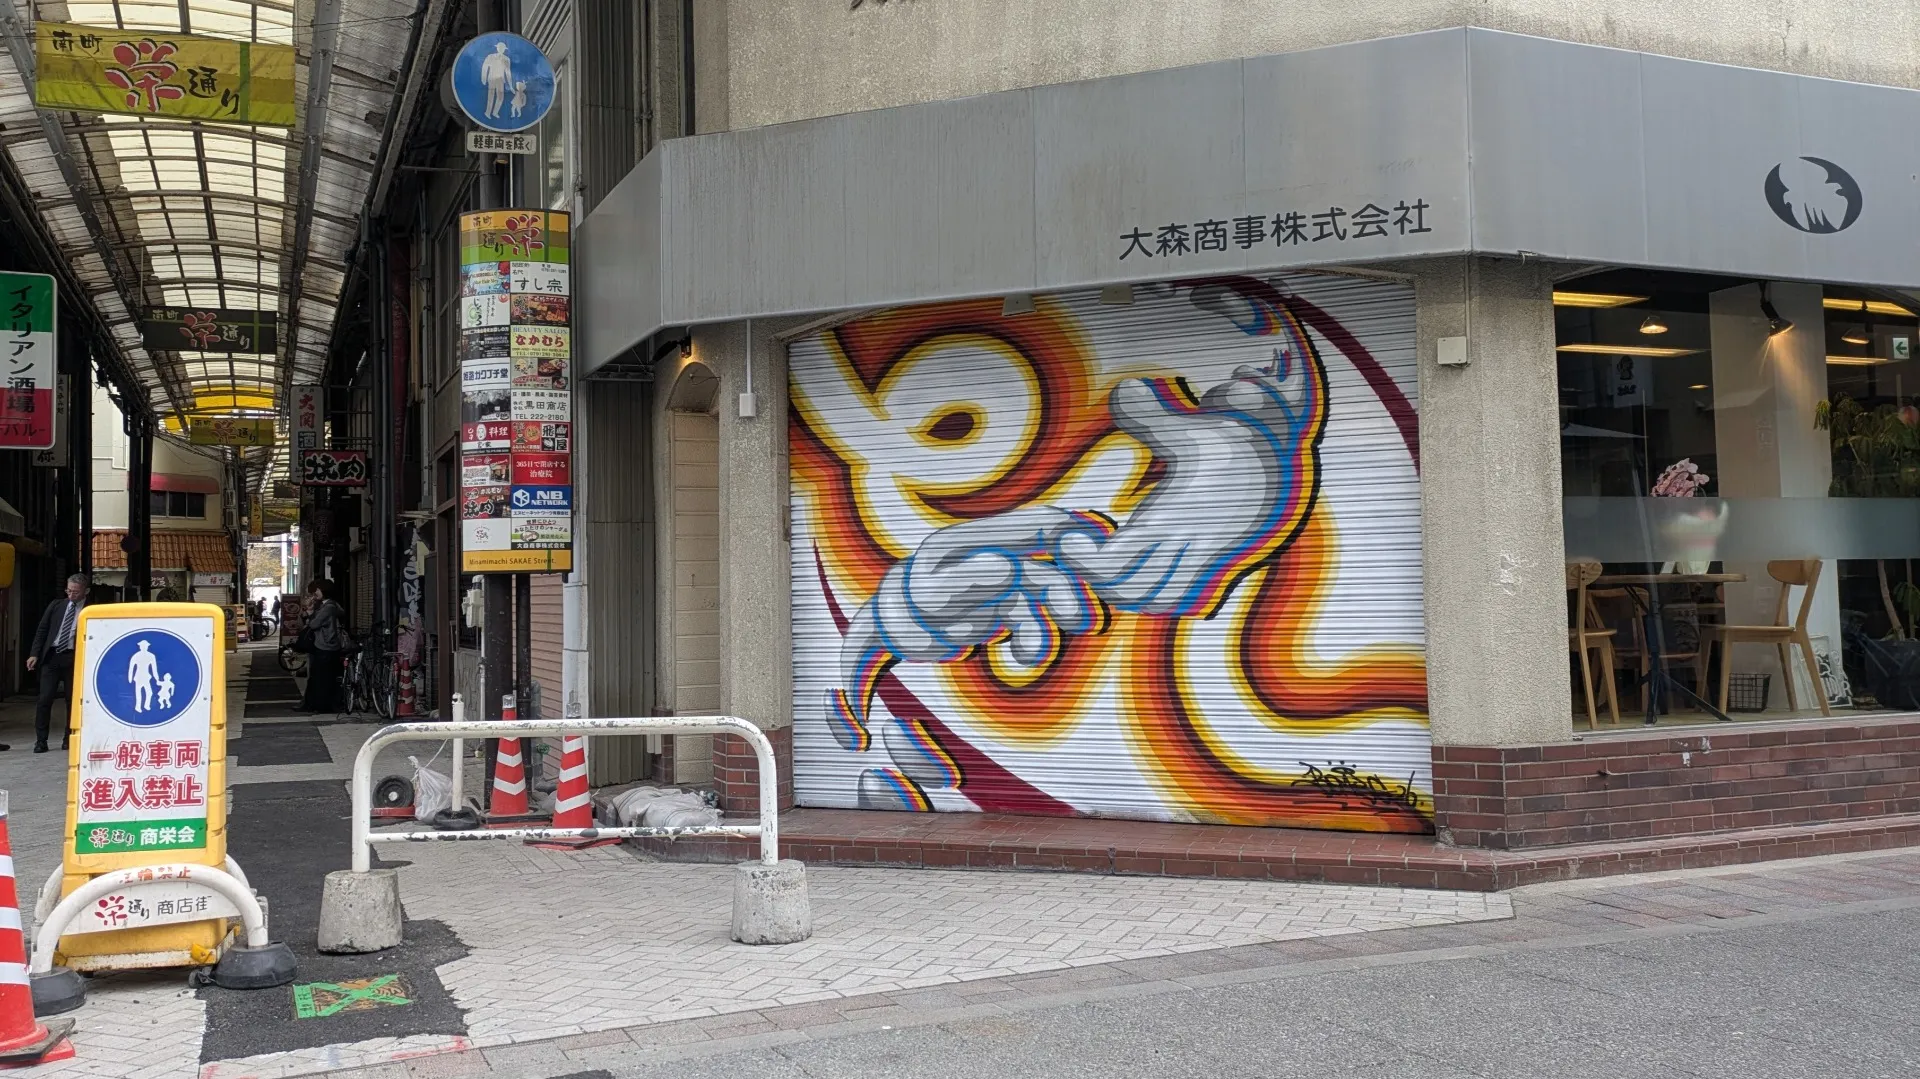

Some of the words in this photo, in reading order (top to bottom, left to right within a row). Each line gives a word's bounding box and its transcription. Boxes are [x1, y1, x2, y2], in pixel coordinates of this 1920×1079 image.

[53, 30, 103, 54] 南町
[473, 135, 530, 151] 軽車両を除く
[1119, 198, 1432, 261] 大森商事株式会社
[515, 277, 563, 293] すし宗
[152, 309, 179, 321] 南町
[7, 285, 36, 413] イタリアン酒場
[516, 335, 564, 347] なかむら
[530, 413, 564, 421] 222-2180
[537, 491, 563, 499] NB
[88, 740, 201, 769] 一般車両
[83, 775, 203, 810] 進入禁止
[140, 826, 195, 846] 商栄会
[157, 895, 212, 916] 商店街
